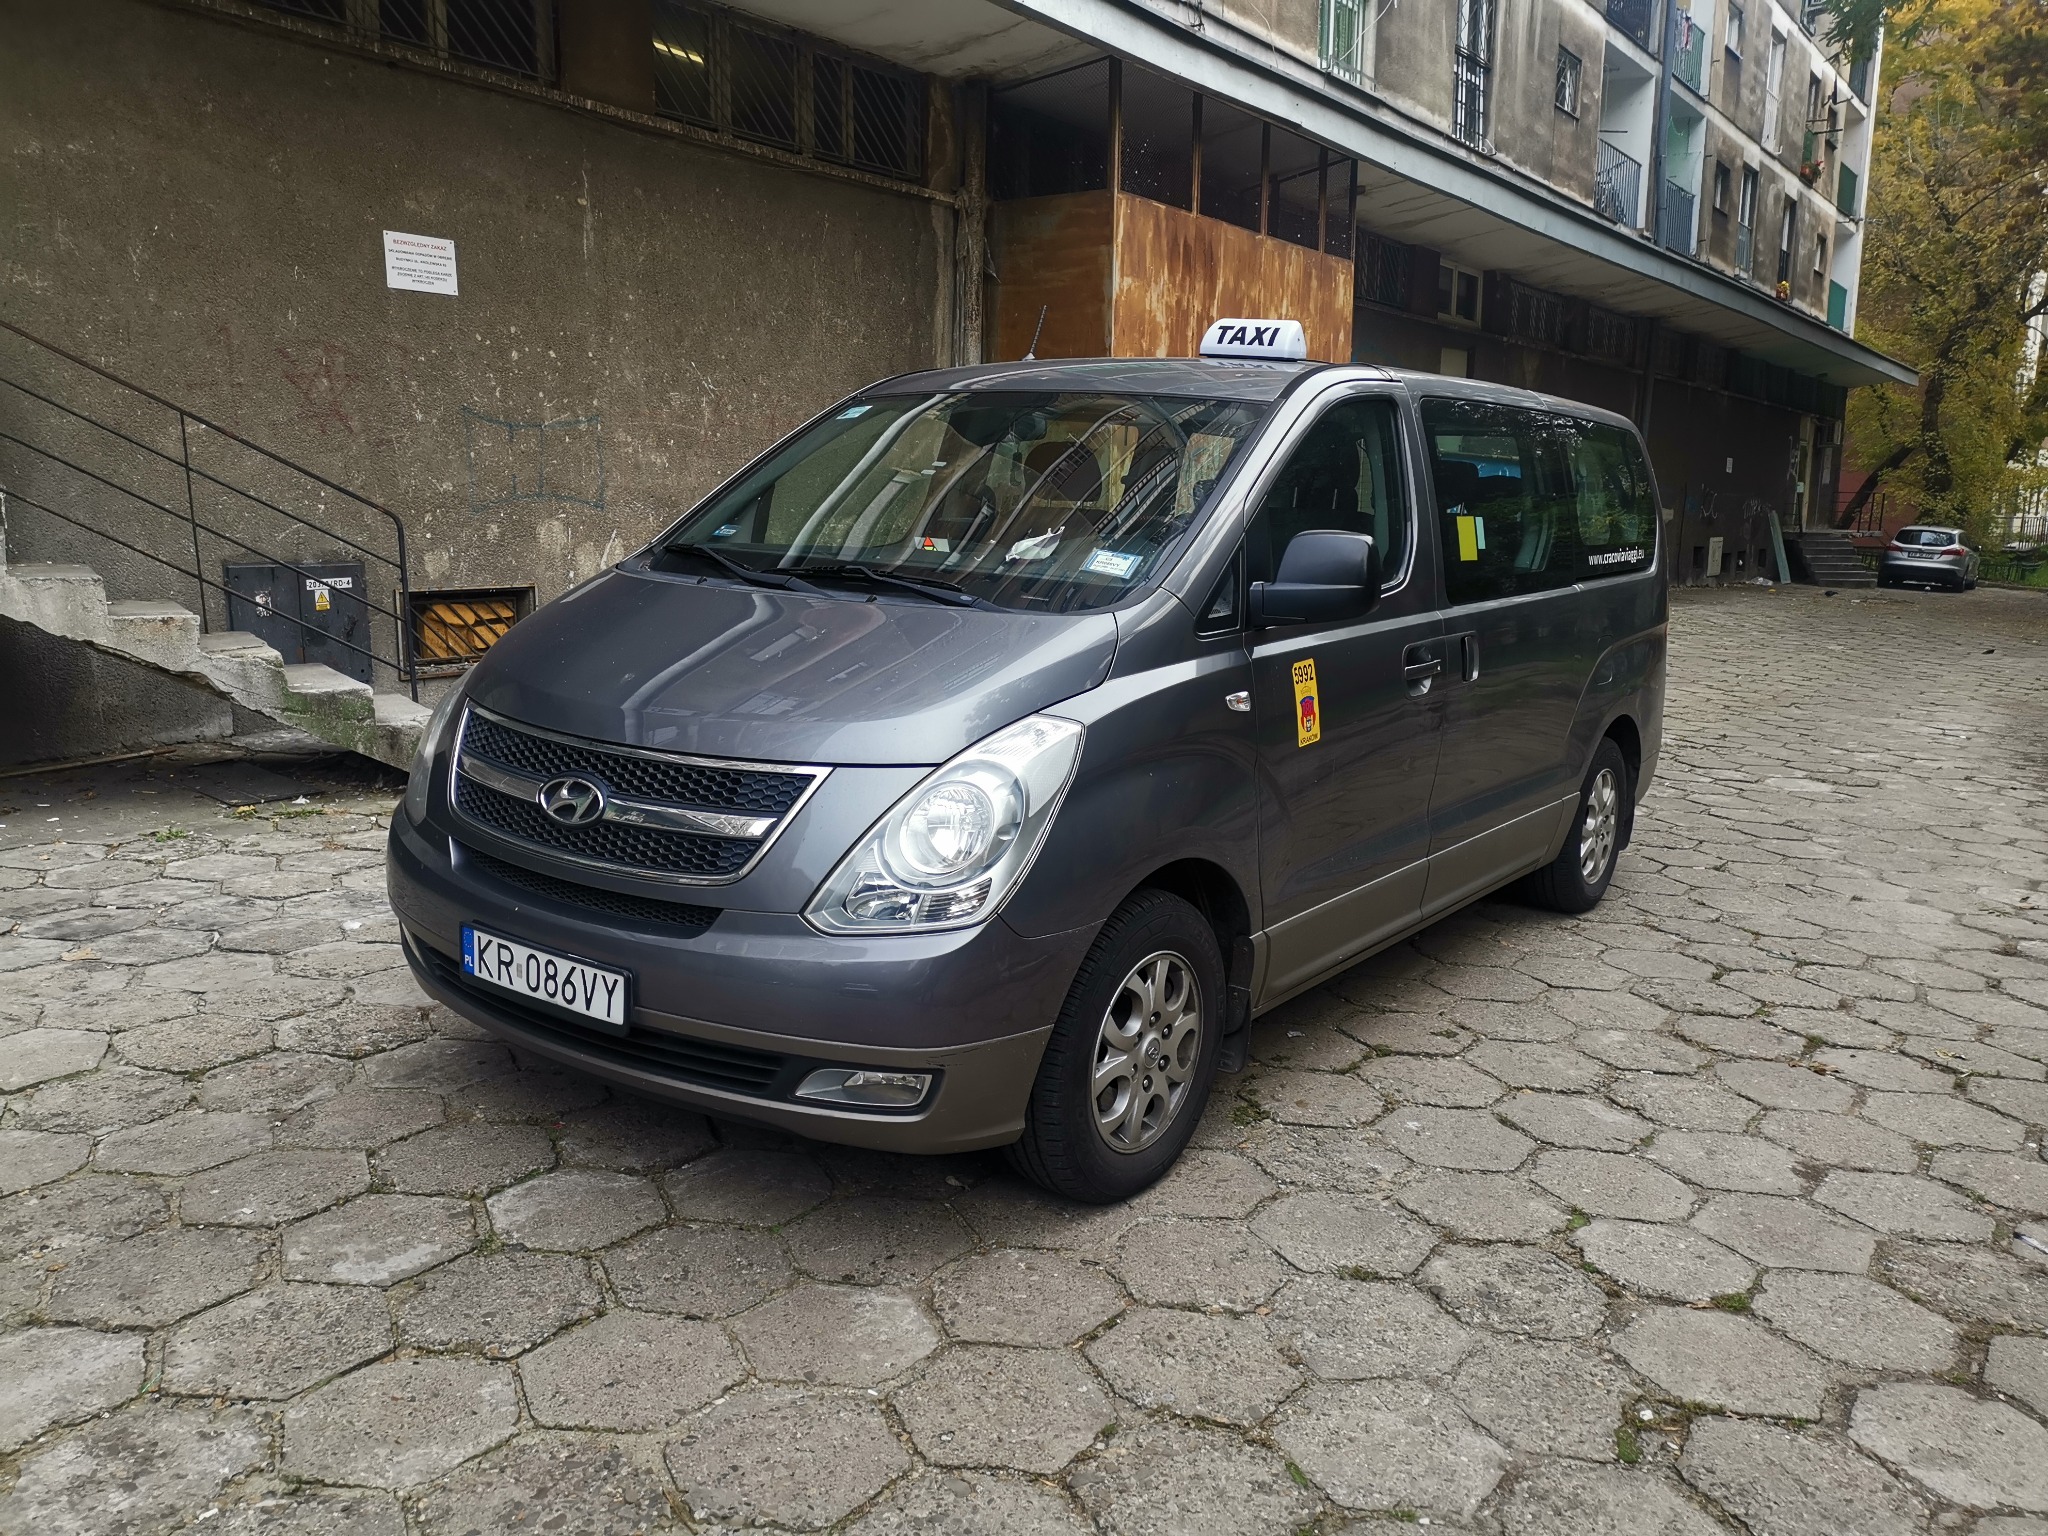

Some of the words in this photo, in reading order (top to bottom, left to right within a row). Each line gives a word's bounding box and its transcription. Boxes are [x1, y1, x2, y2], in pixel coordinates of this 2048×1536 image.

[1217, 325, 1280, 346] TAXI
[1589, 546, 1644, 565] www.cracoviaviaggi.eu
[1294, 664, 1314, 685] 5992
[464, 954, 473, 967] PL
[477, 935, 514, 986] KR
[526, 953, 619, 1018] 086VY
